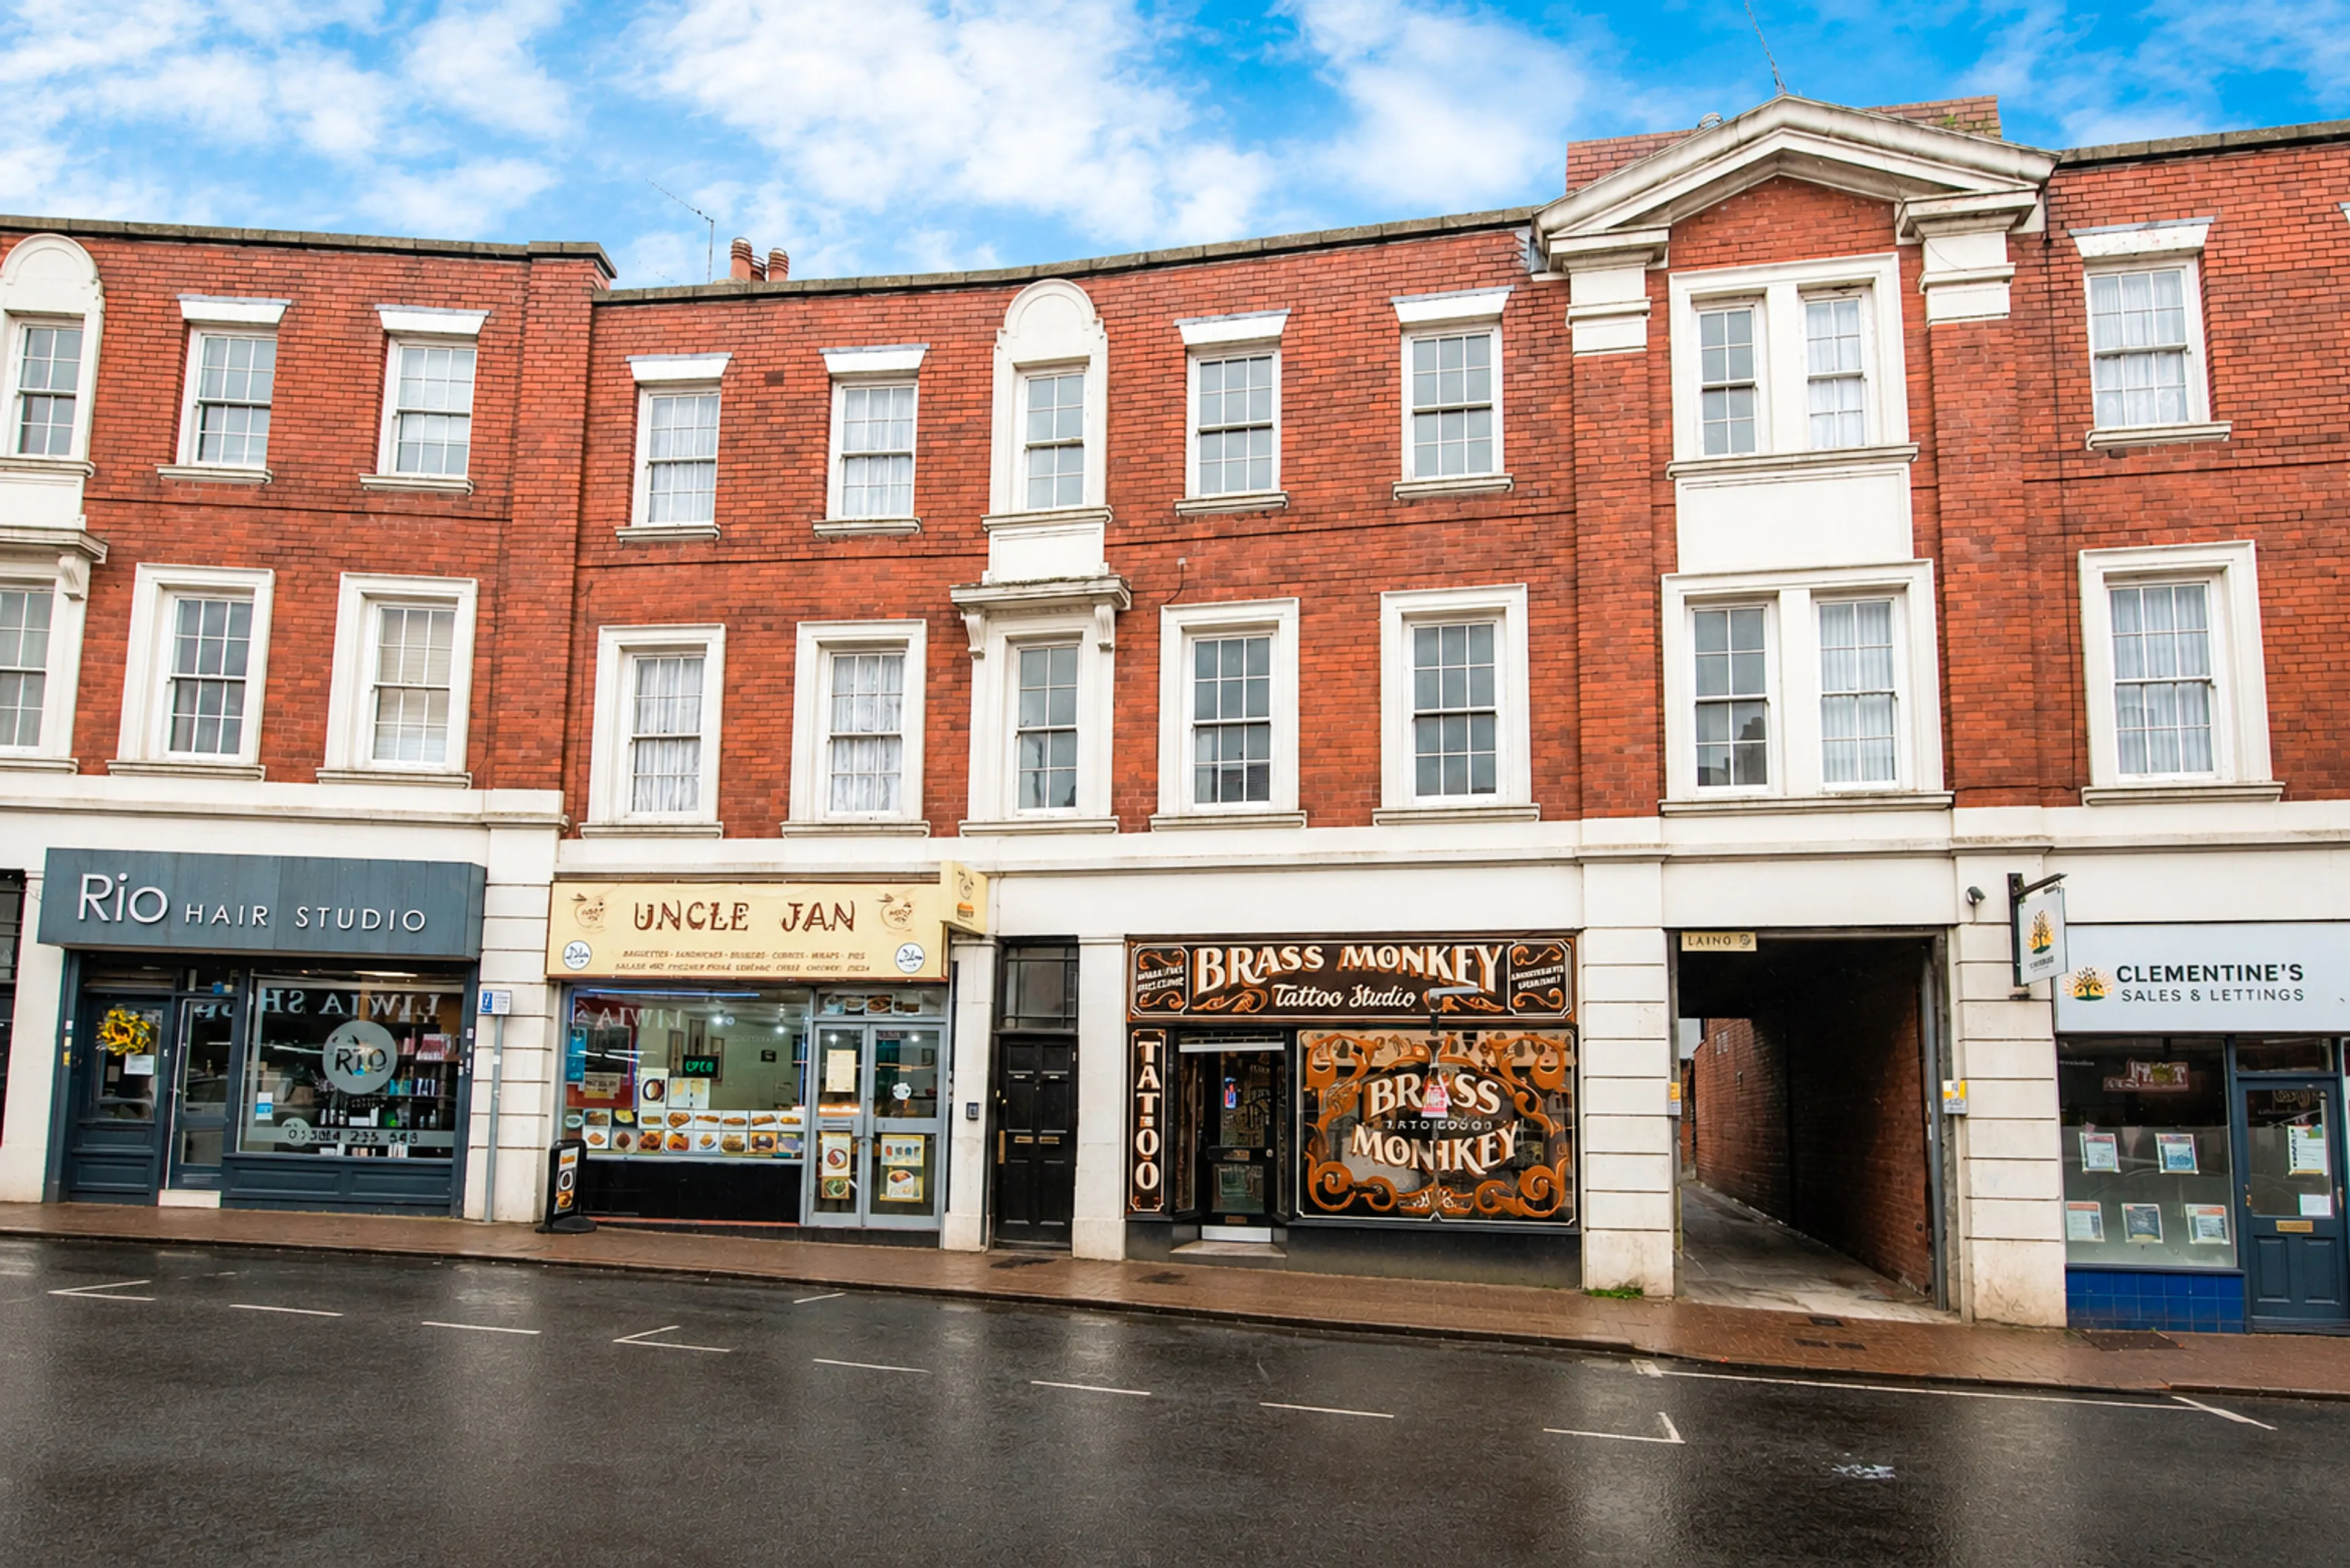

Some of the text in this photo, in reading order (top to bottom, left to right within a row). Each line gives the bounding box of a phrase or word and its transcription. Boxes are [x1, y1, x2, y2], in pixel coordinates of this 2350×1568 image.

[78, 872, 426, 933] Rio HAIR STUDIO
[633, 900, 750, 931] UNCLE
[780, 900, 856, 932] JAN
[1196, 946, 1504, 995] BRASS MONKEY
[2116, 964, 2303, 983] CLEMENTINE'S
[1272, 983, 1416, 1008] Tattoo Studio
[2122, 988, 2304, 1002] SALES & LETTINGS
